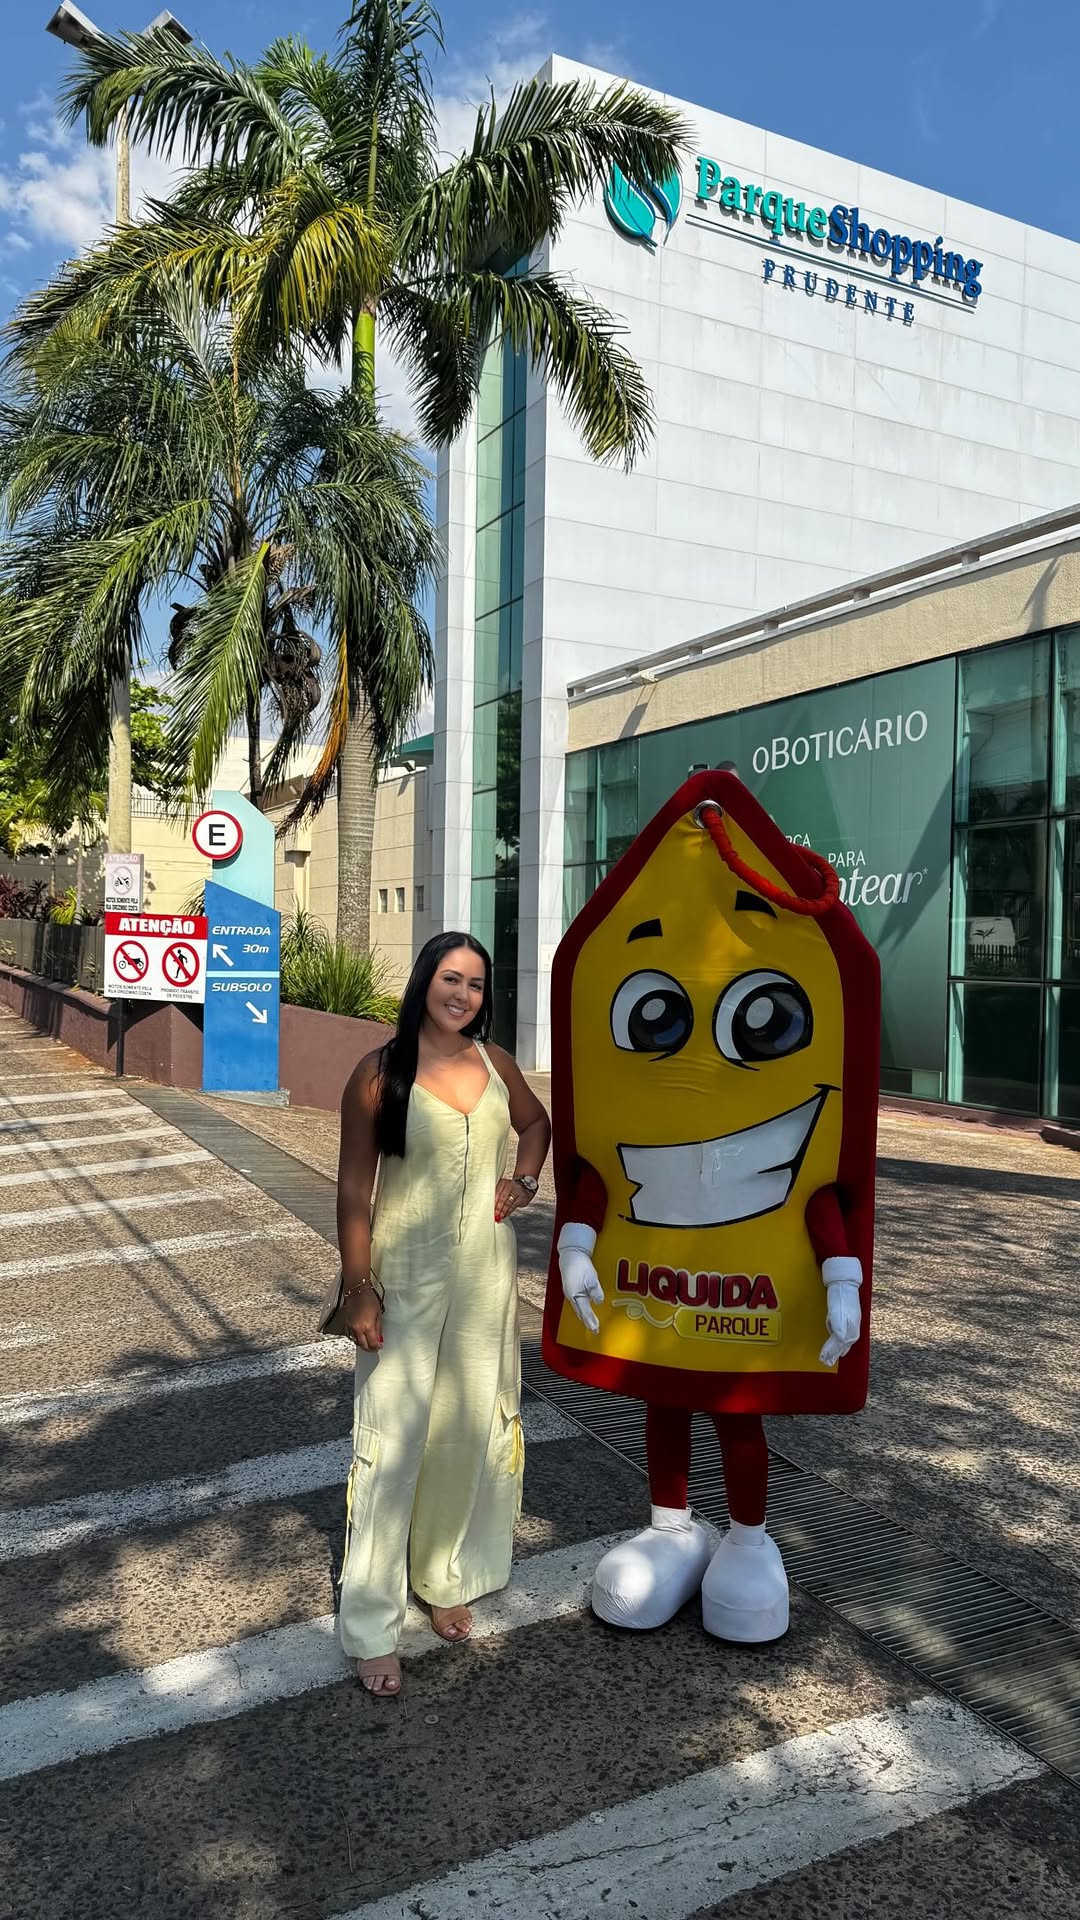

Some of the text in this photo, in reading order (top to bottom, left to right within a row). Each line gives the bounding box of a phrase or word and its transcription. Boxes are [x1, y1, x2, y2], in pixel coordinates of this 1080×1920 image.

[696, 156, 983, 298] ParqueShopping
[762, 258, 916, 324] PRUDENTE
[208, 823, 226, 846] E
[828, 850, 866, 867] PARA
[118, 917, 195, 936] ATENÇÃO
[212, 925, 271, 936] ENTRADA
[242, 944, 269, 954] 30m
[211, 982, 272, 993] SUBSOLO
[616, 1257, 779, 1311] LIQUIDA
[694, 1314, 770, 1336] PARQUE
